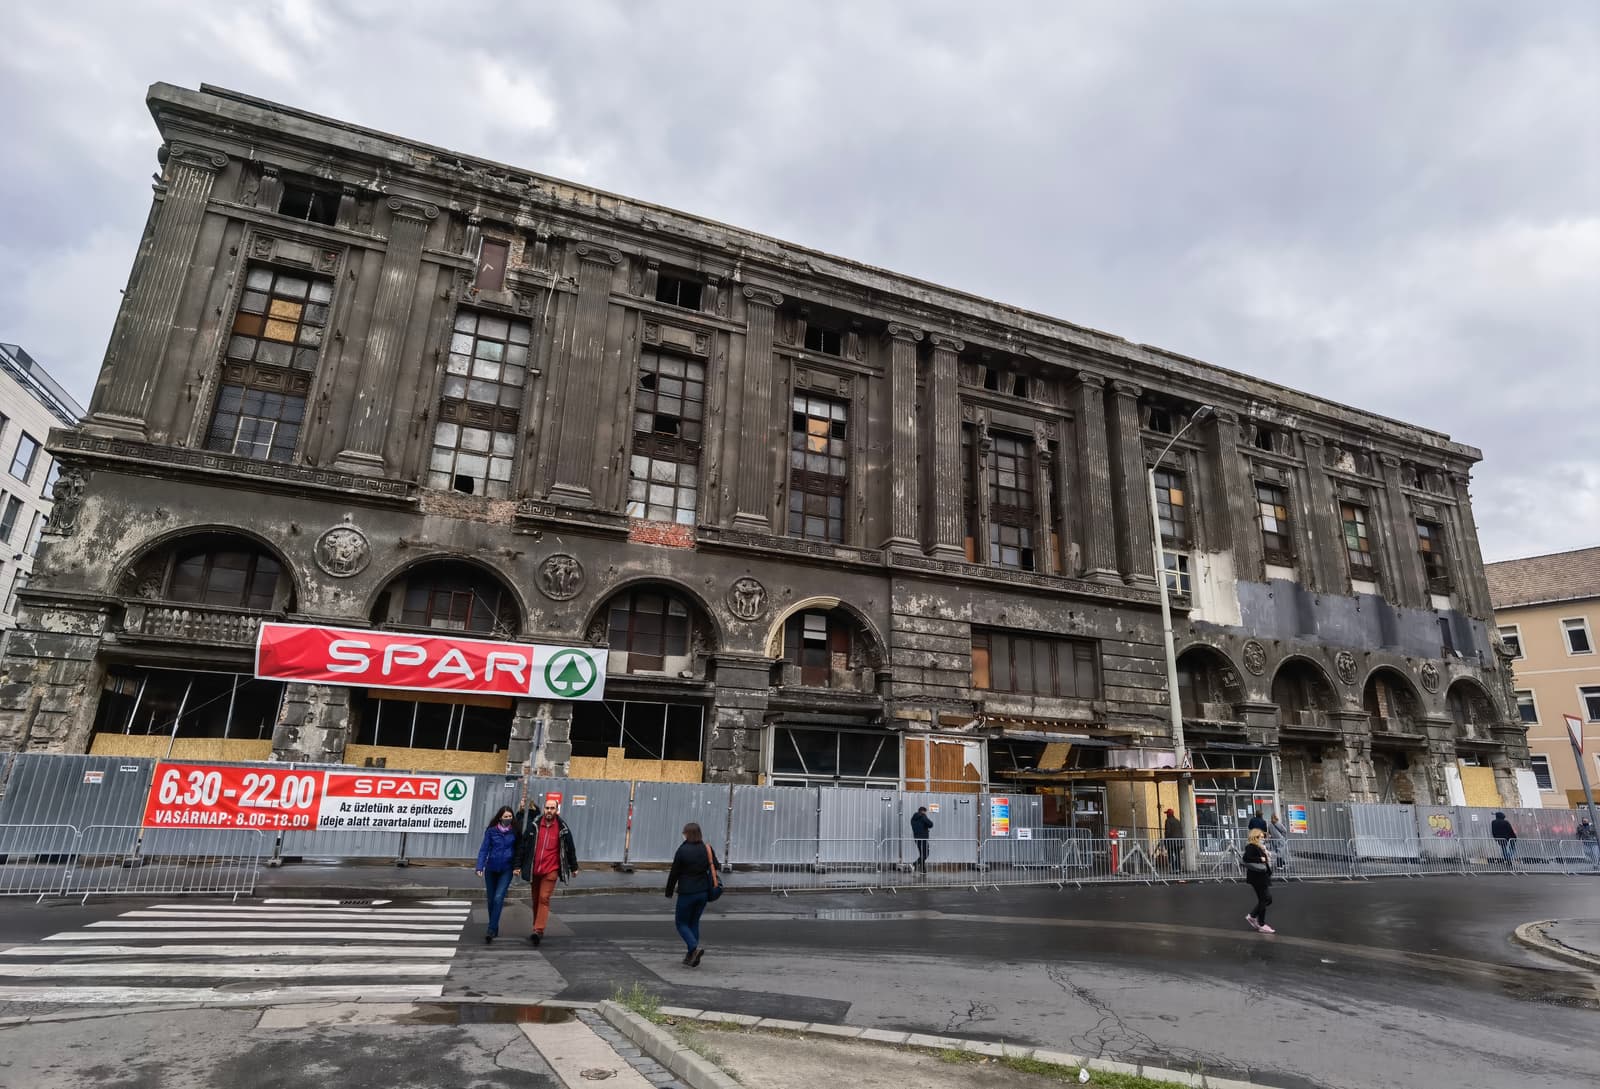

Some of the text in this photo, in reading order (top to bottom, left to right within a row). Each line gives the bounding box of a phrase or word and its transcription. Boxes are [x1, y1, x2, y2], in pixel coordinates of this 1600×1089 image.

[327, 639, 527, 684] SPAR
[354, 779, 437, 796] SPAR
[155, 808, 308, 826] VASÁRNAP: 8.00-18.00
[340, 802, 453, 816] Az üzletünk az építkezés
[320, 816, 467, 829] ideje alatt zavartalanul üzemel.
